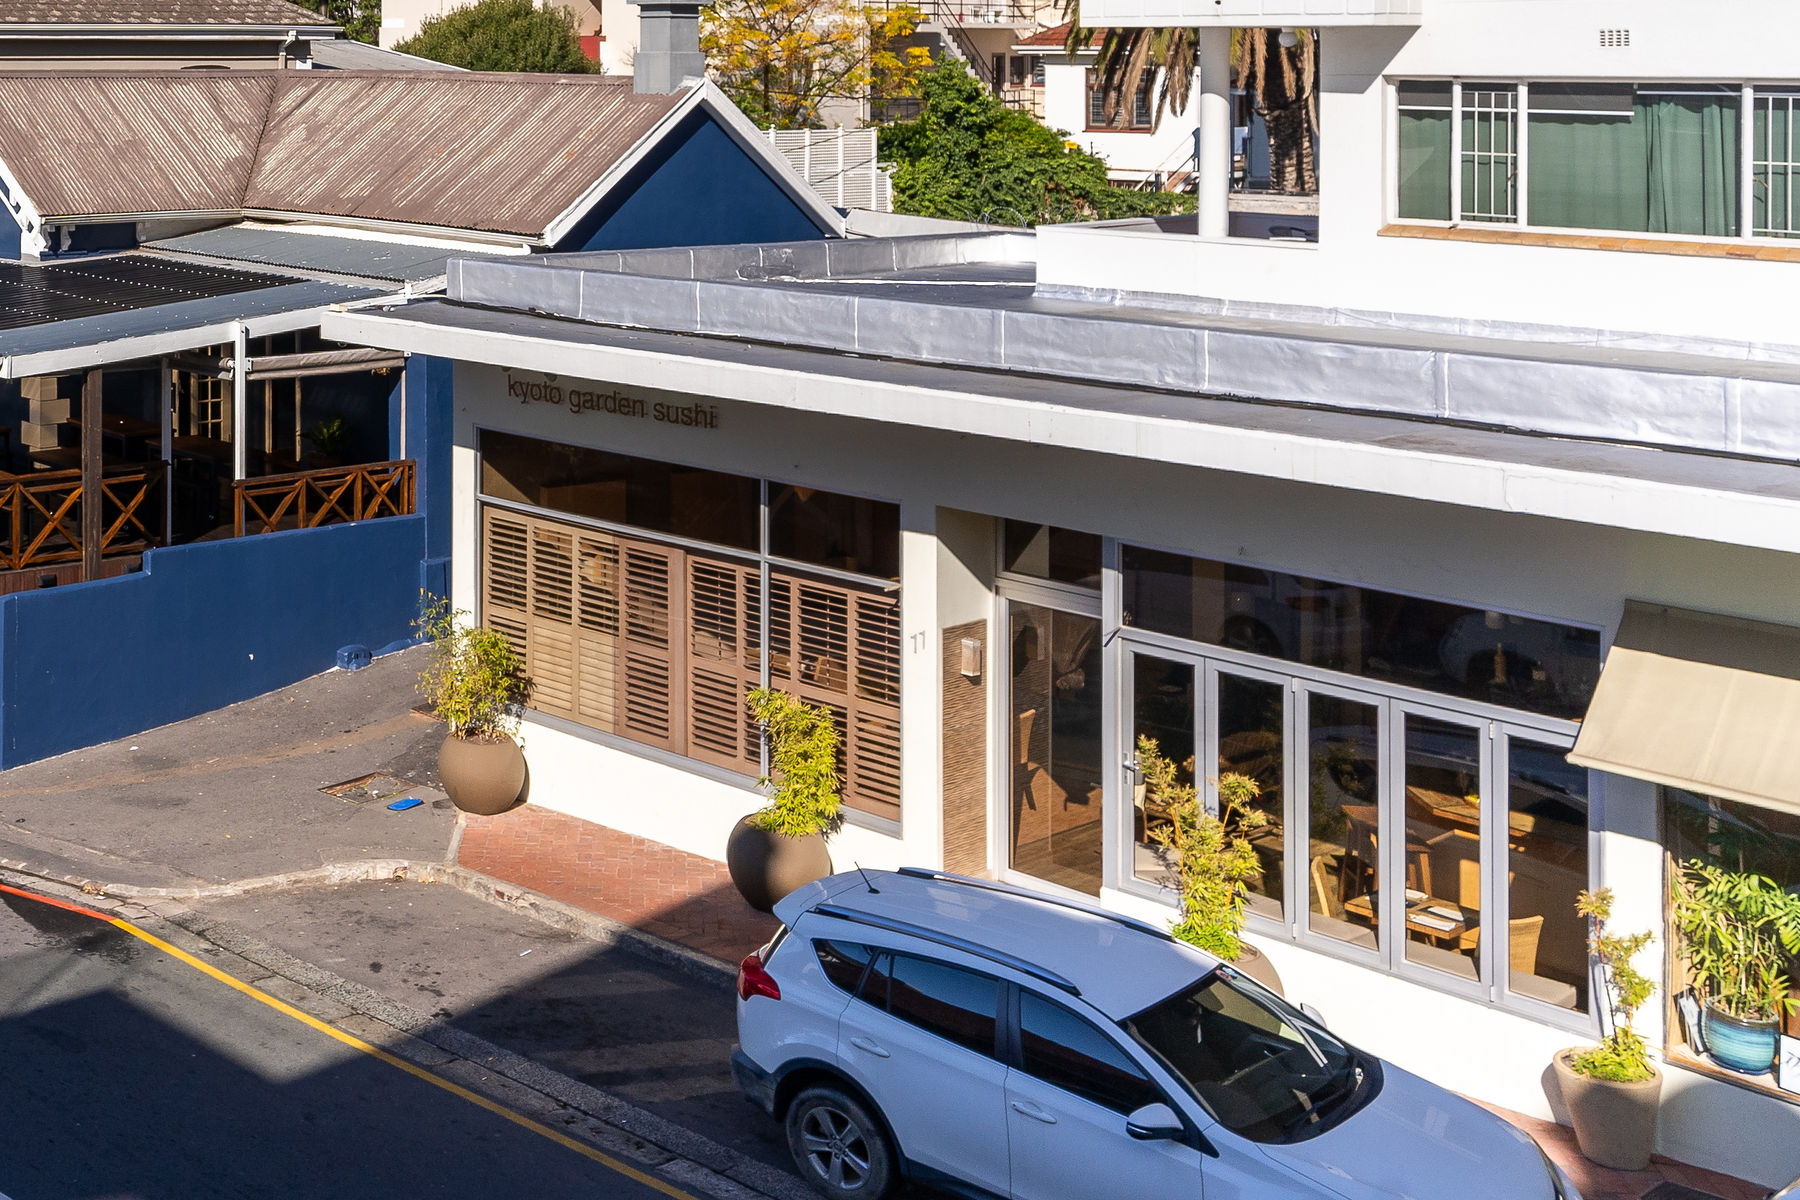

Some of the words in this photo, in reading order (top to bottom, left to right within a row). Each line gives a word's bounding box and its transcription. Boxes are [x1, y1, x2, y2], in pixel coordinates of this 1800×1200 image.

[507, 374, 562, 404] kyoto
[568, 388, 646, 418] garden
[653, 401, 717, 429] sushi
